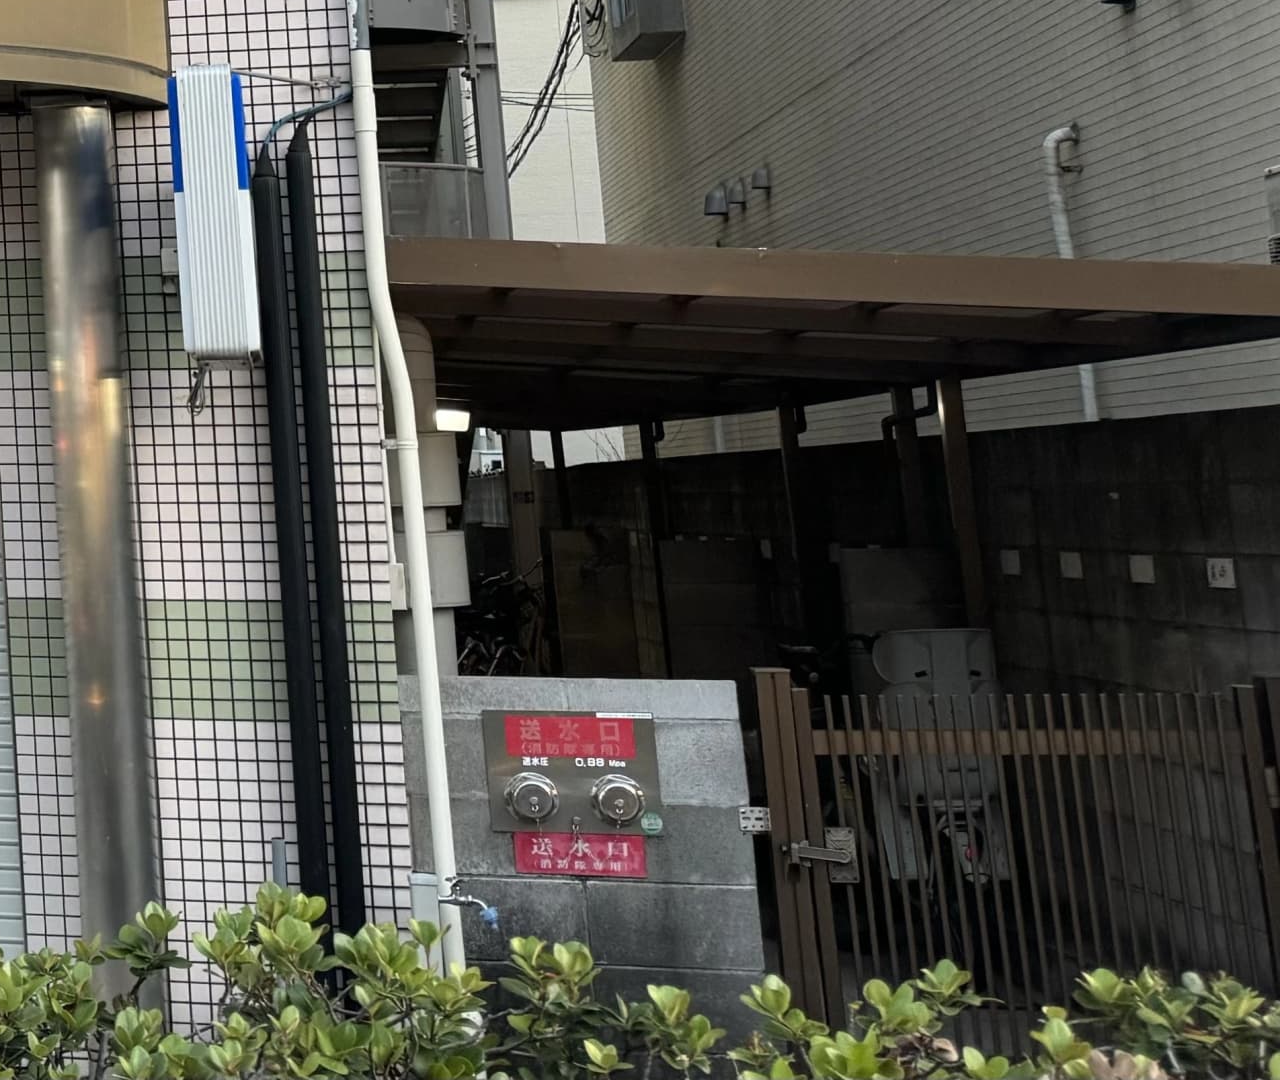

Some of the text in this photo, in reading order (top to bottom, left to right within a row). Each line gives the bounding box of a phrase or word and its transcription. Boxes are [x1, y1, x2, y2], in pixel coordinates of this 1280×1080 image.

[519, 719, 621, 742] 送水口
[530, 837, 630, 858] 送水口
